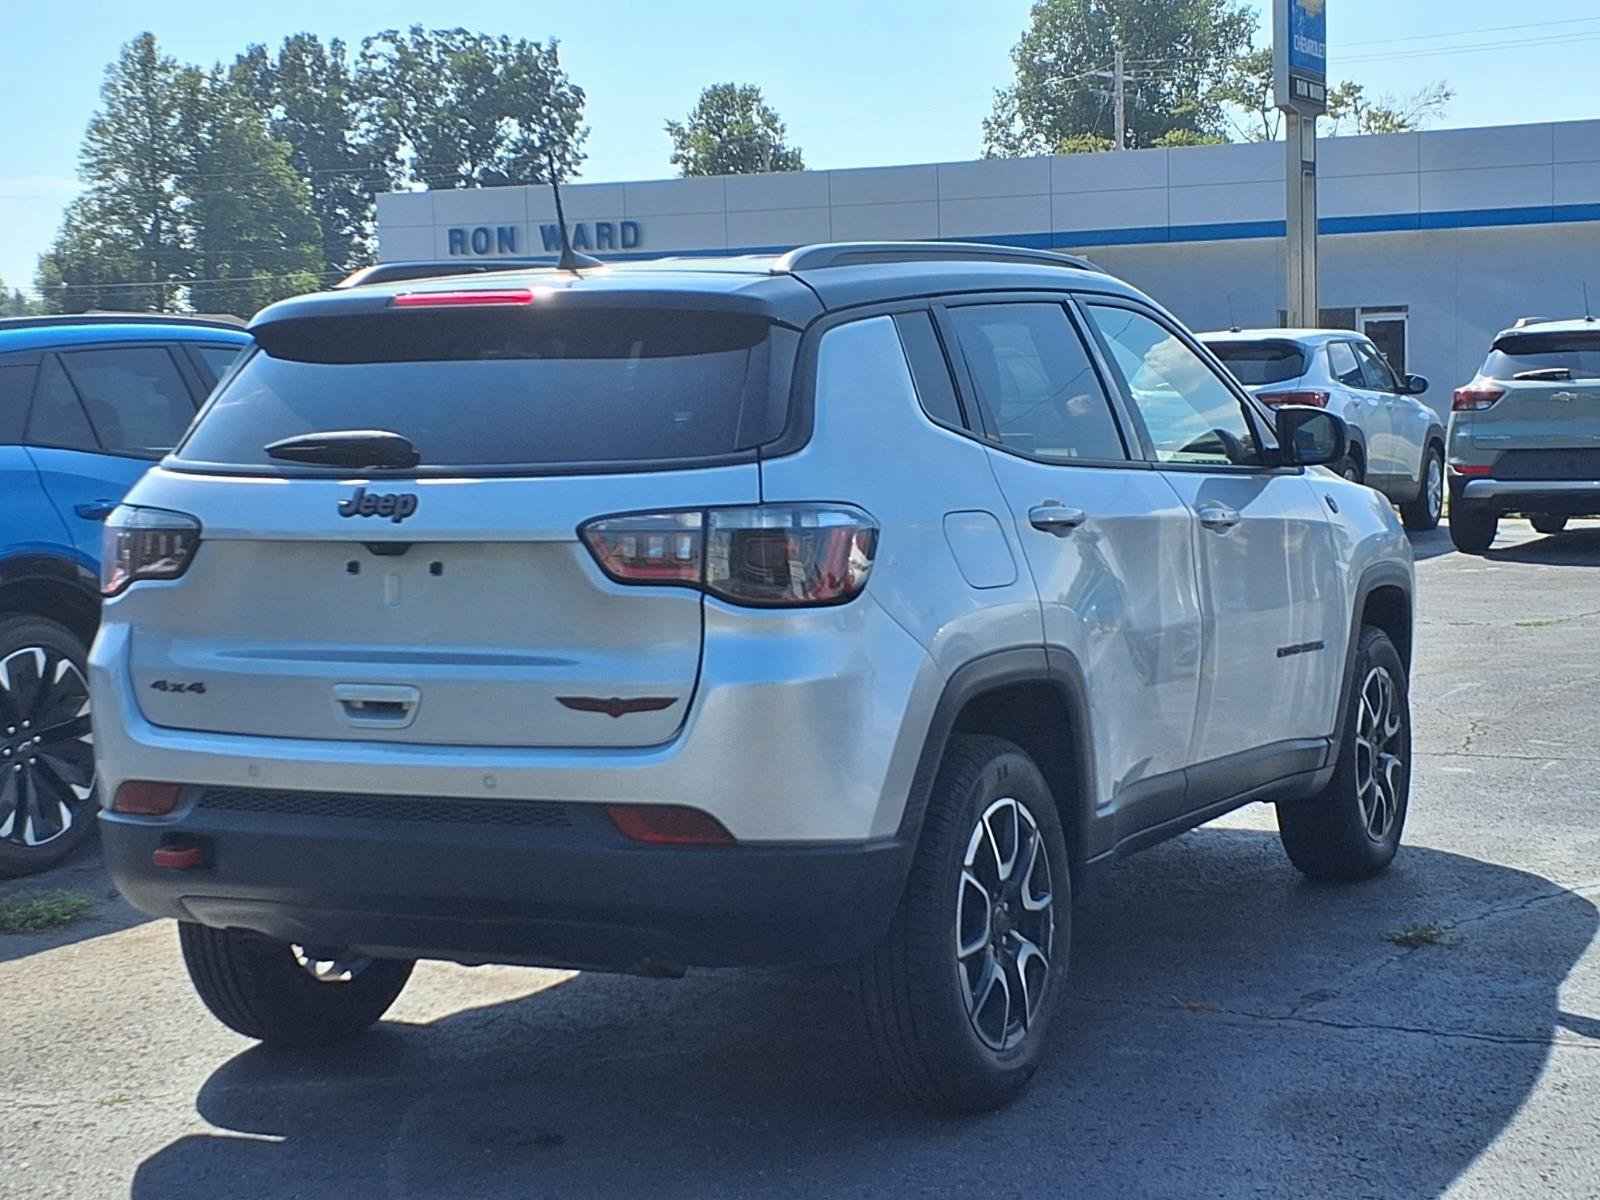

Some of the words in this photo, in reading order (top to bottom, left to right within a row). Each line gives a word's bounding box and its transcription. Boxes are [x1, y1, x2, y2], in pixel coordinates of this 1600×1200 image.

[448, 226, 516, 256] RON
[539, 220, 641, 252] WARD
[337, 486, 418, 524] Jeep
